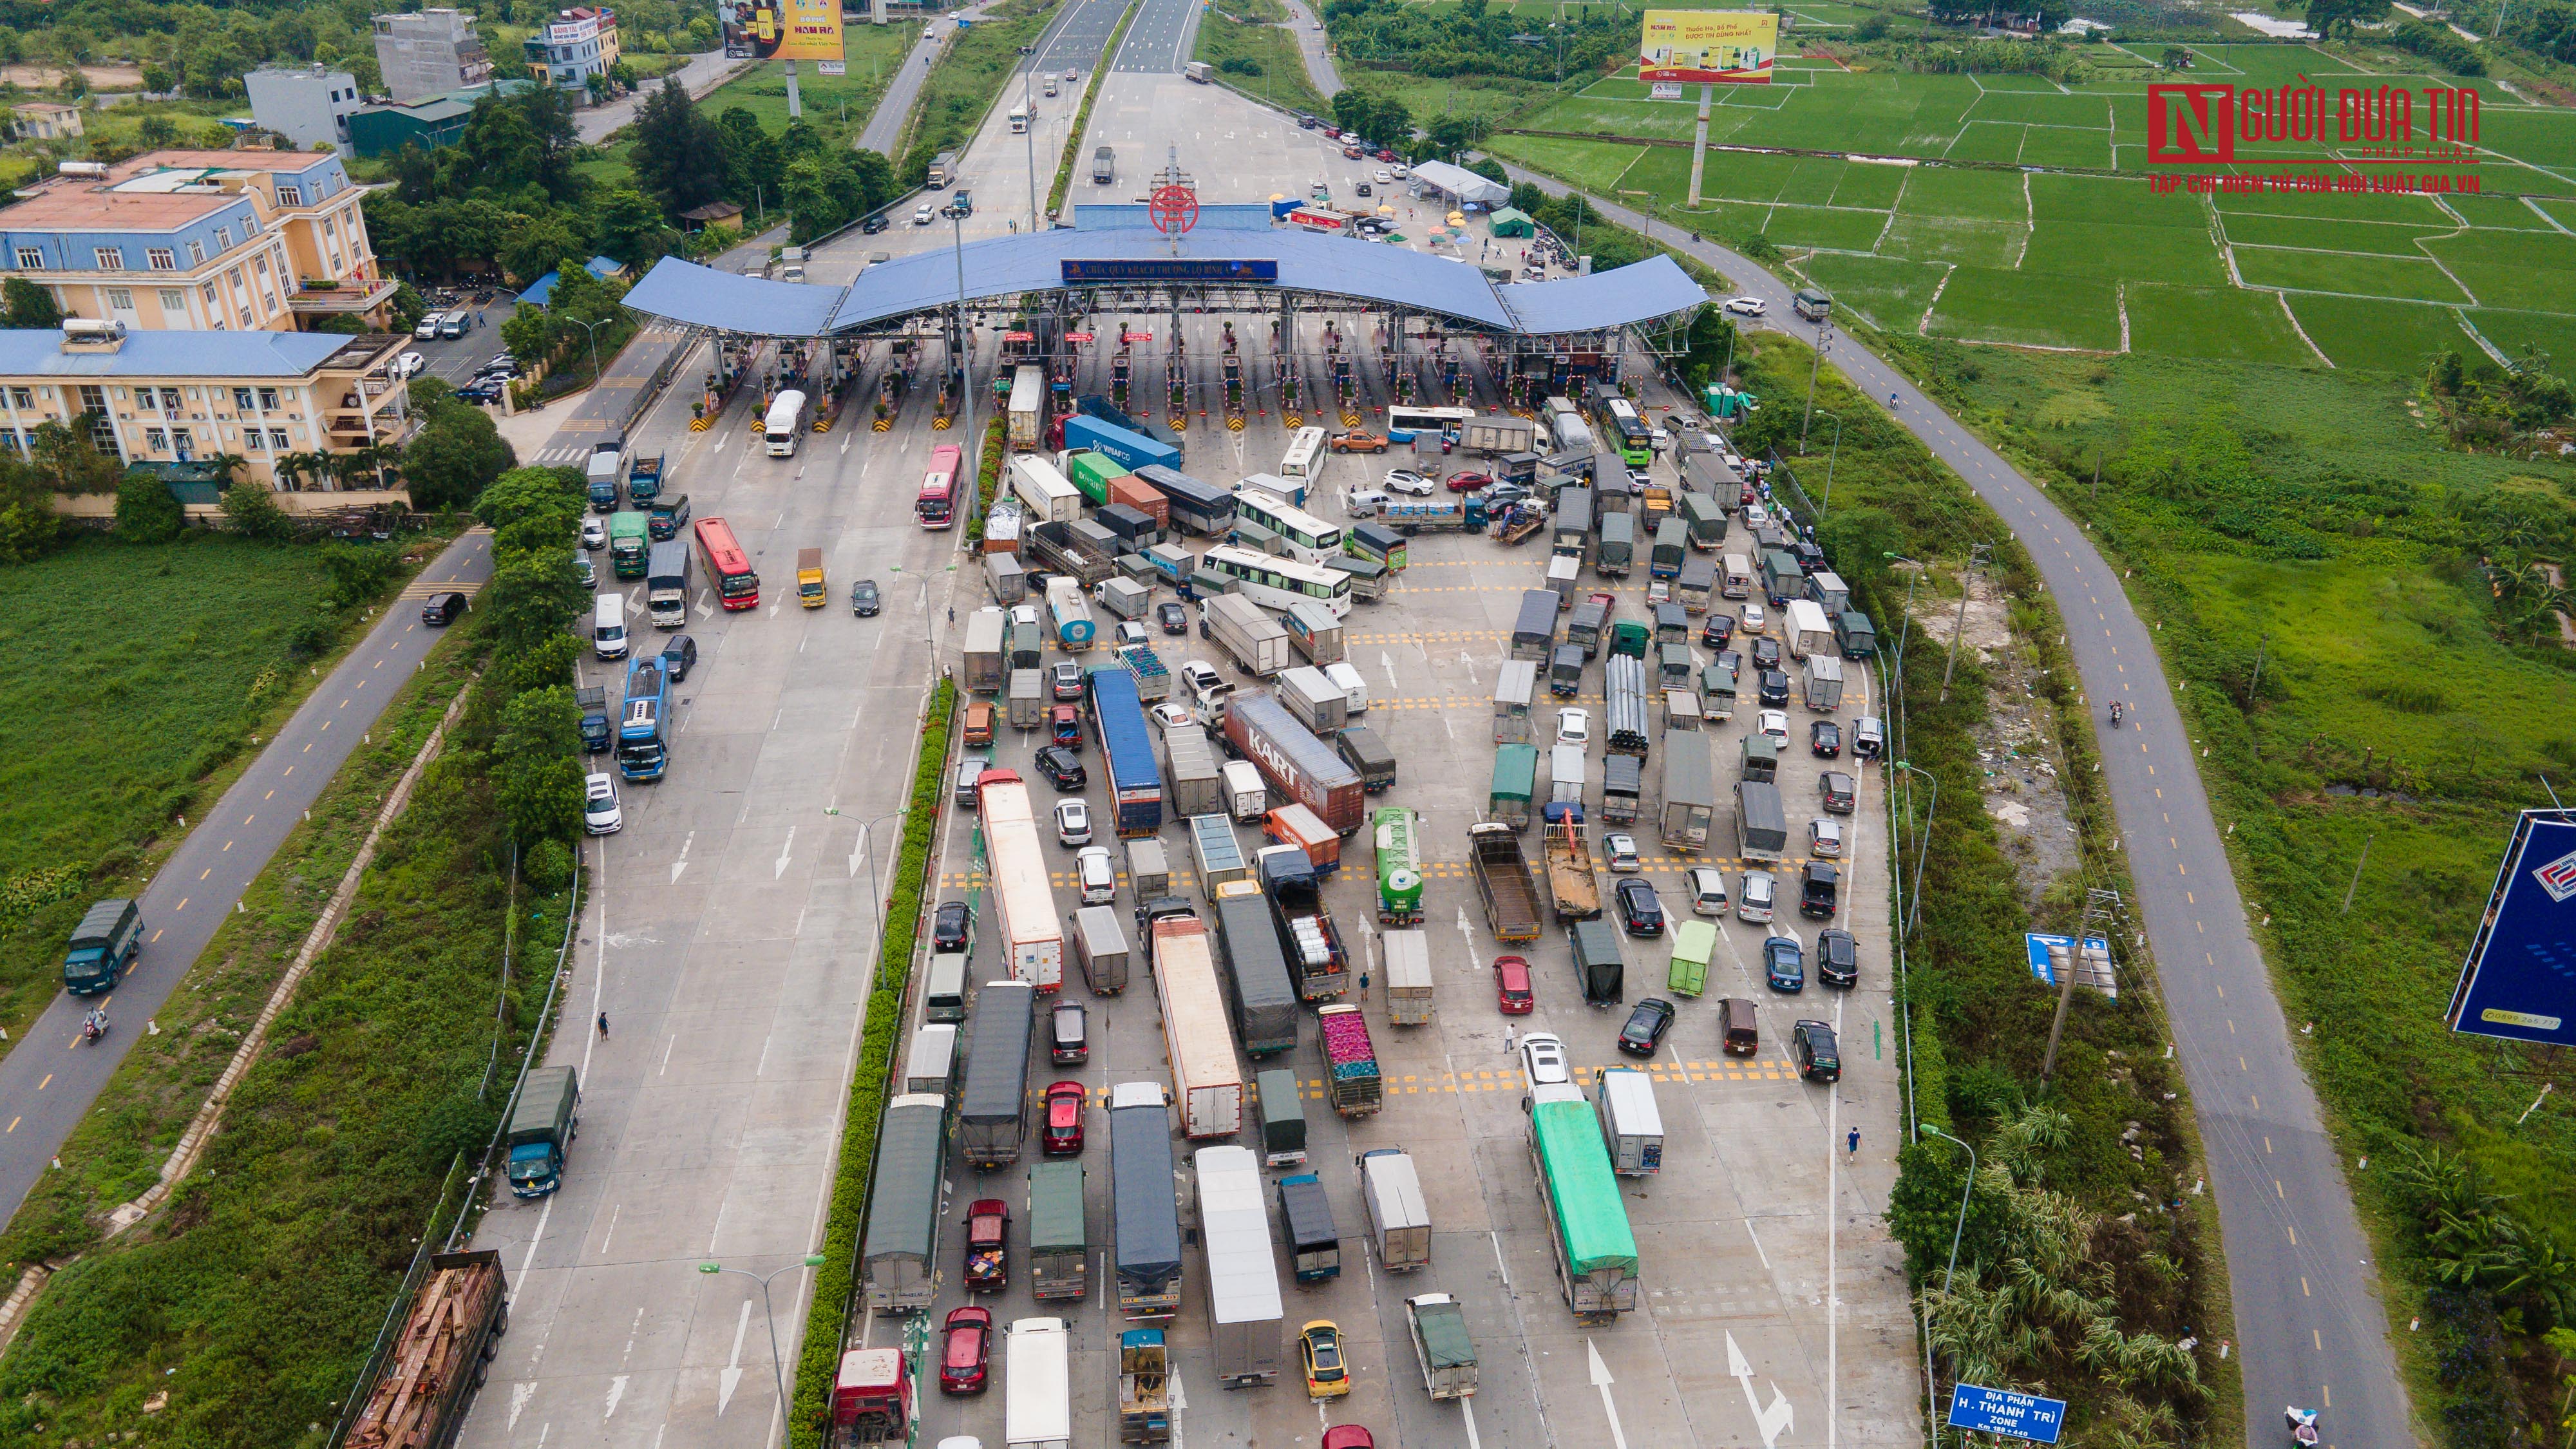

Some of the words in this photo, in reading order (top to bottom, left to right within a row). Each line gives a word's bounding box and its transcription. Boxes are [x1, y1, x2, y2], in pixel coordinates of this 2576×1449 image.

[1249, 727, 1298, 786] KART
[1985, 1391, 2003, 1403] ĐỊA
[2007, 1395, 2034, 1408] PHẬN
[1979, 1401, 2025, 1418] THANH
[2033, 1410, 2056, 1423] TRÌ
[1990, 1416, 2018, 1428] ZONE
